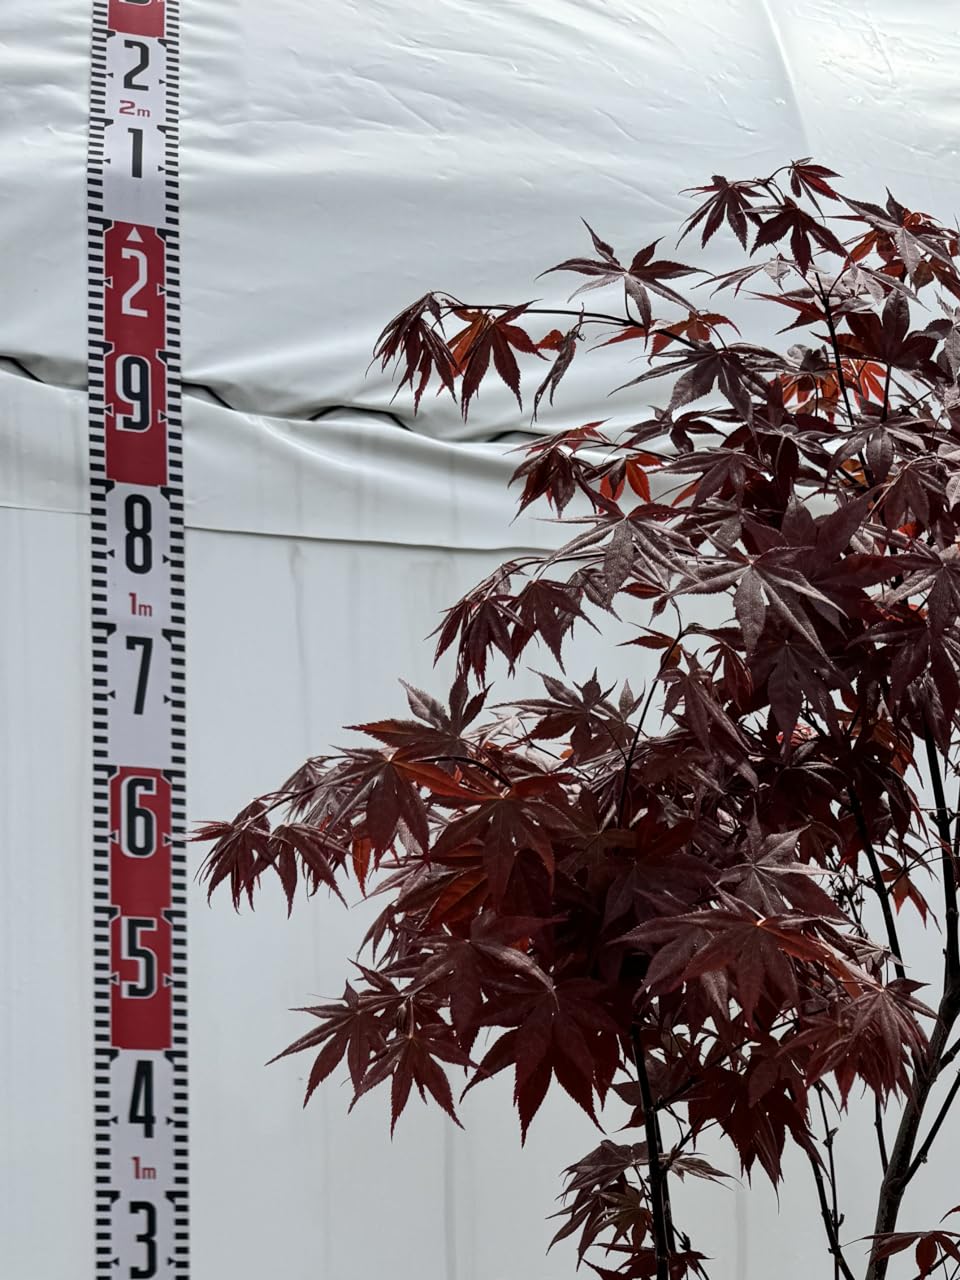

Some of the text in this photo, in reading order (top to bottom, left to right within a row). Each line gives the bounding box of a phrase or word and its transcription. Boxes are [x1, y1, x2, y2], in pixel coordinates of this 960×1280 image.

[123, 39, 150, 91] 2
[119, 99, 151, 118] 2m
[127, 128, 143, 178] 1
[121, 247, 149, 317] 2
[115, 354, 152, 433] 9
[125, 493, 152, 575] 8
[128, 592, 153, 617] 1m
[126, 635, 153, 715] 7
[120, 775, 157, 858] 6
[120, 916, 157, 999] 5
[128, 1060, 156, 1139] 4
[131, 1156, 157, 1180] 1m
[129, 1201, 157, 1280] 3
